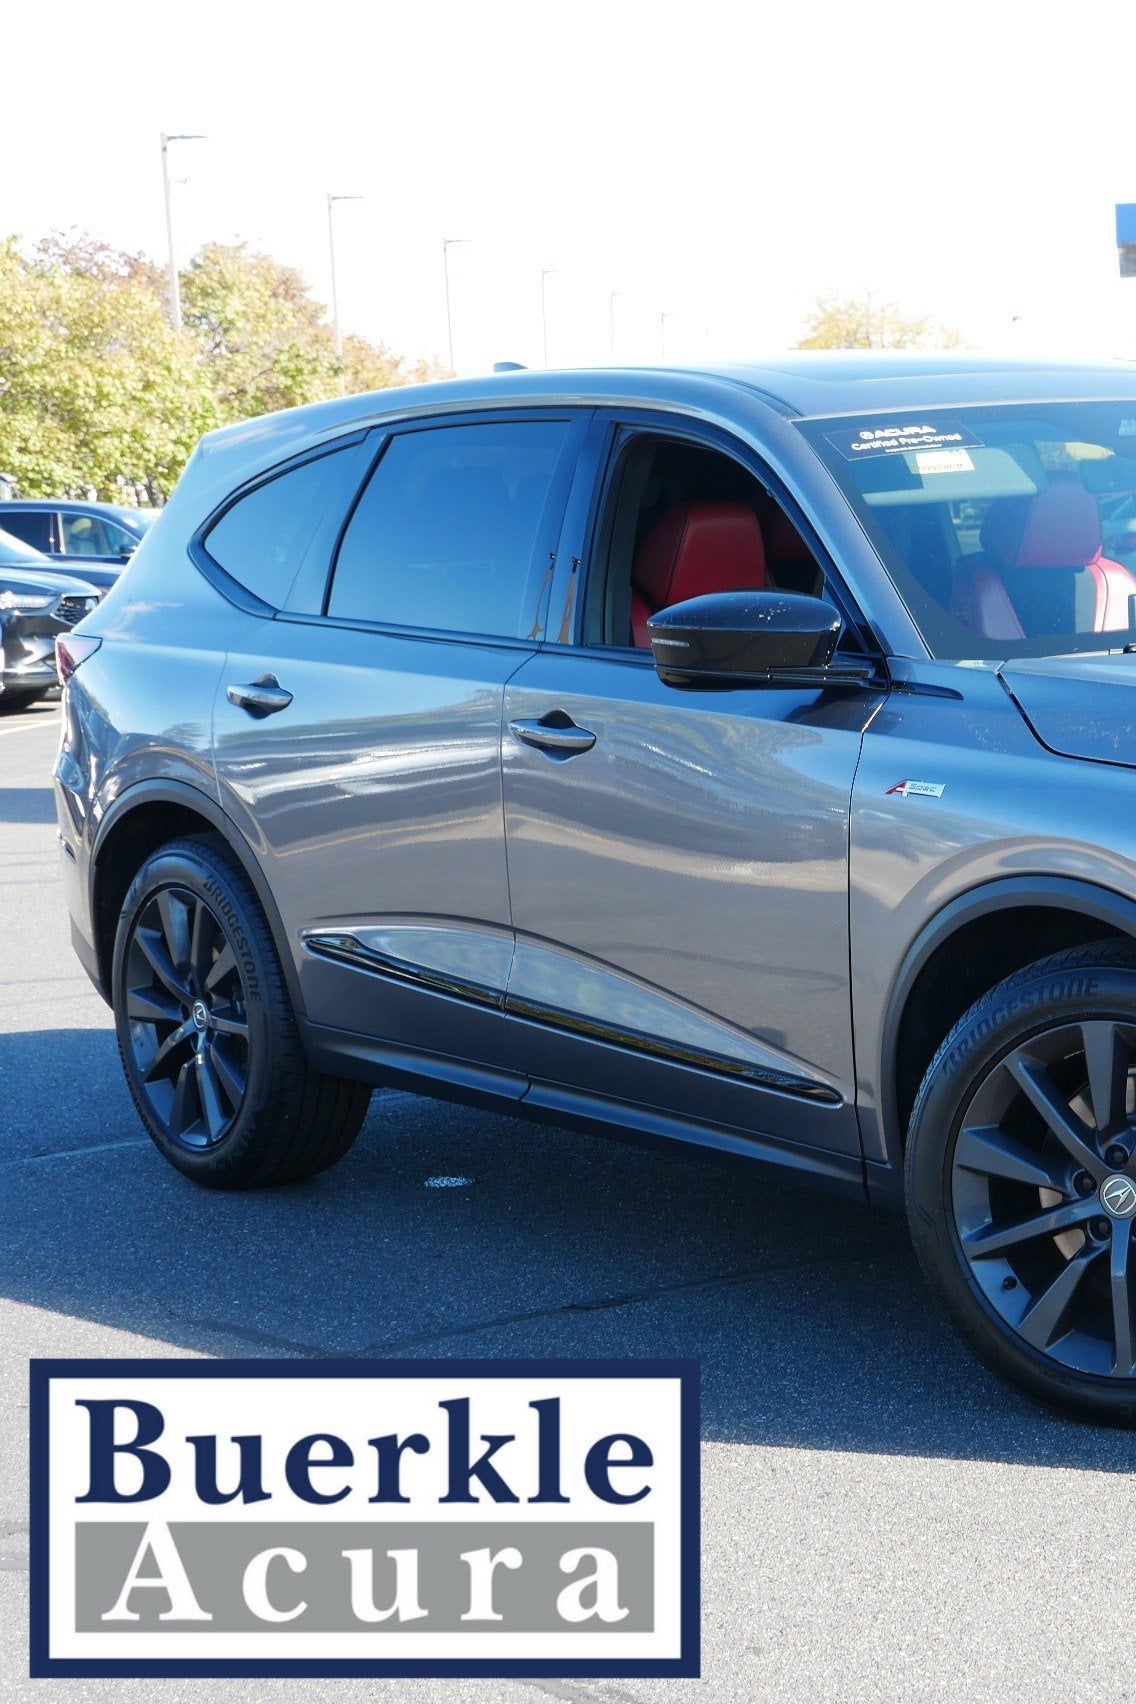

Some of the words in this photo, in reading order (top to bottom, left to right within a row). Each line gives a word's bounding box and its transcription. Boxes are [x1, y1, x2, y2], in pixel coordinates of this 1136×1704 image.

[851, 439, 898, 451] Certified
[899, 433, 962, 445] Pre-Owned
[874, 426, 936, 438] ACURA
[203, 873, 262, 1003] BRIDGESTONE
[942, 975, 1101, 1084] BRIDGESTONE
